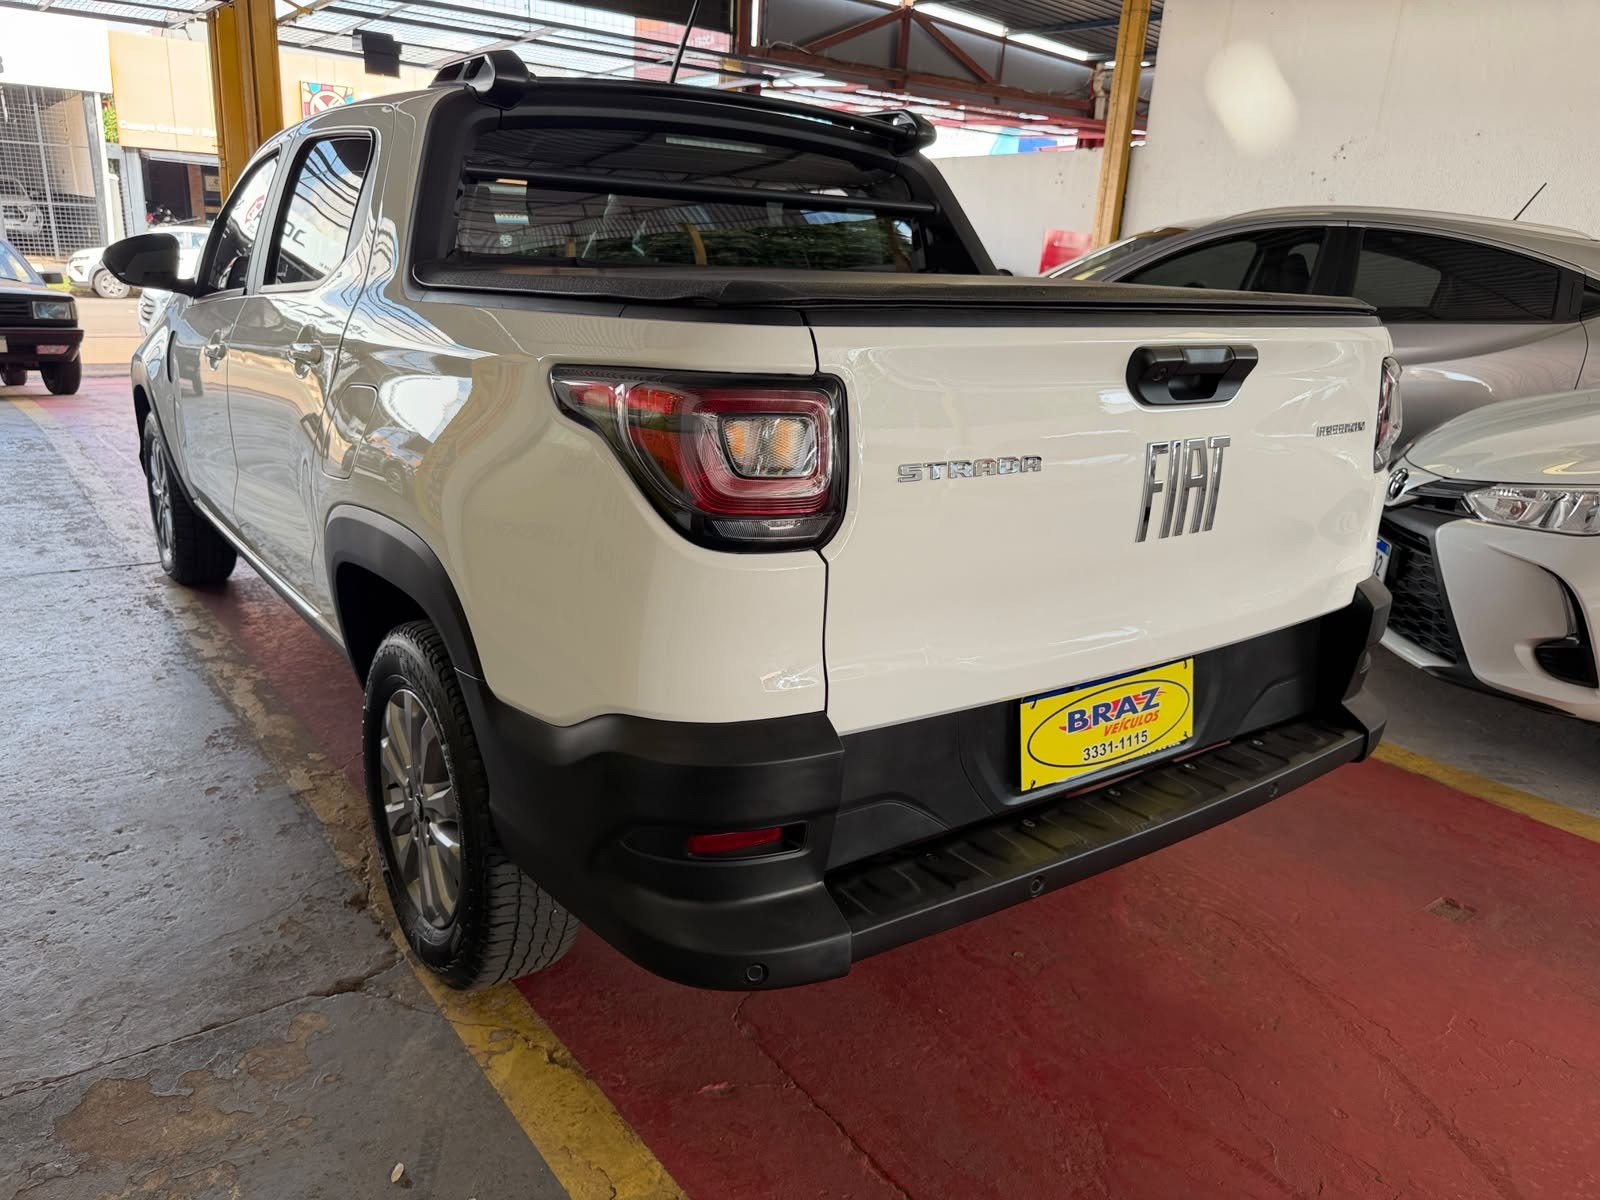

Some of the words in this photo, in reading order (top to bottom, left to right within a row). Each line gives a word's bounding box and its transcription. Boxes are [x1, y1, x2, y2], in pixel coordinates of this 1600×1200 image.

[898, 455, 1042, 483] STRADA
[1135, 435, 1231, 543] FIAT
[1066, 687, 1161, 734] BRAZ
[1104, 709, 1160, 737] VEÍCULOS
[1083, 730, 1148, 761] 3331-1115
